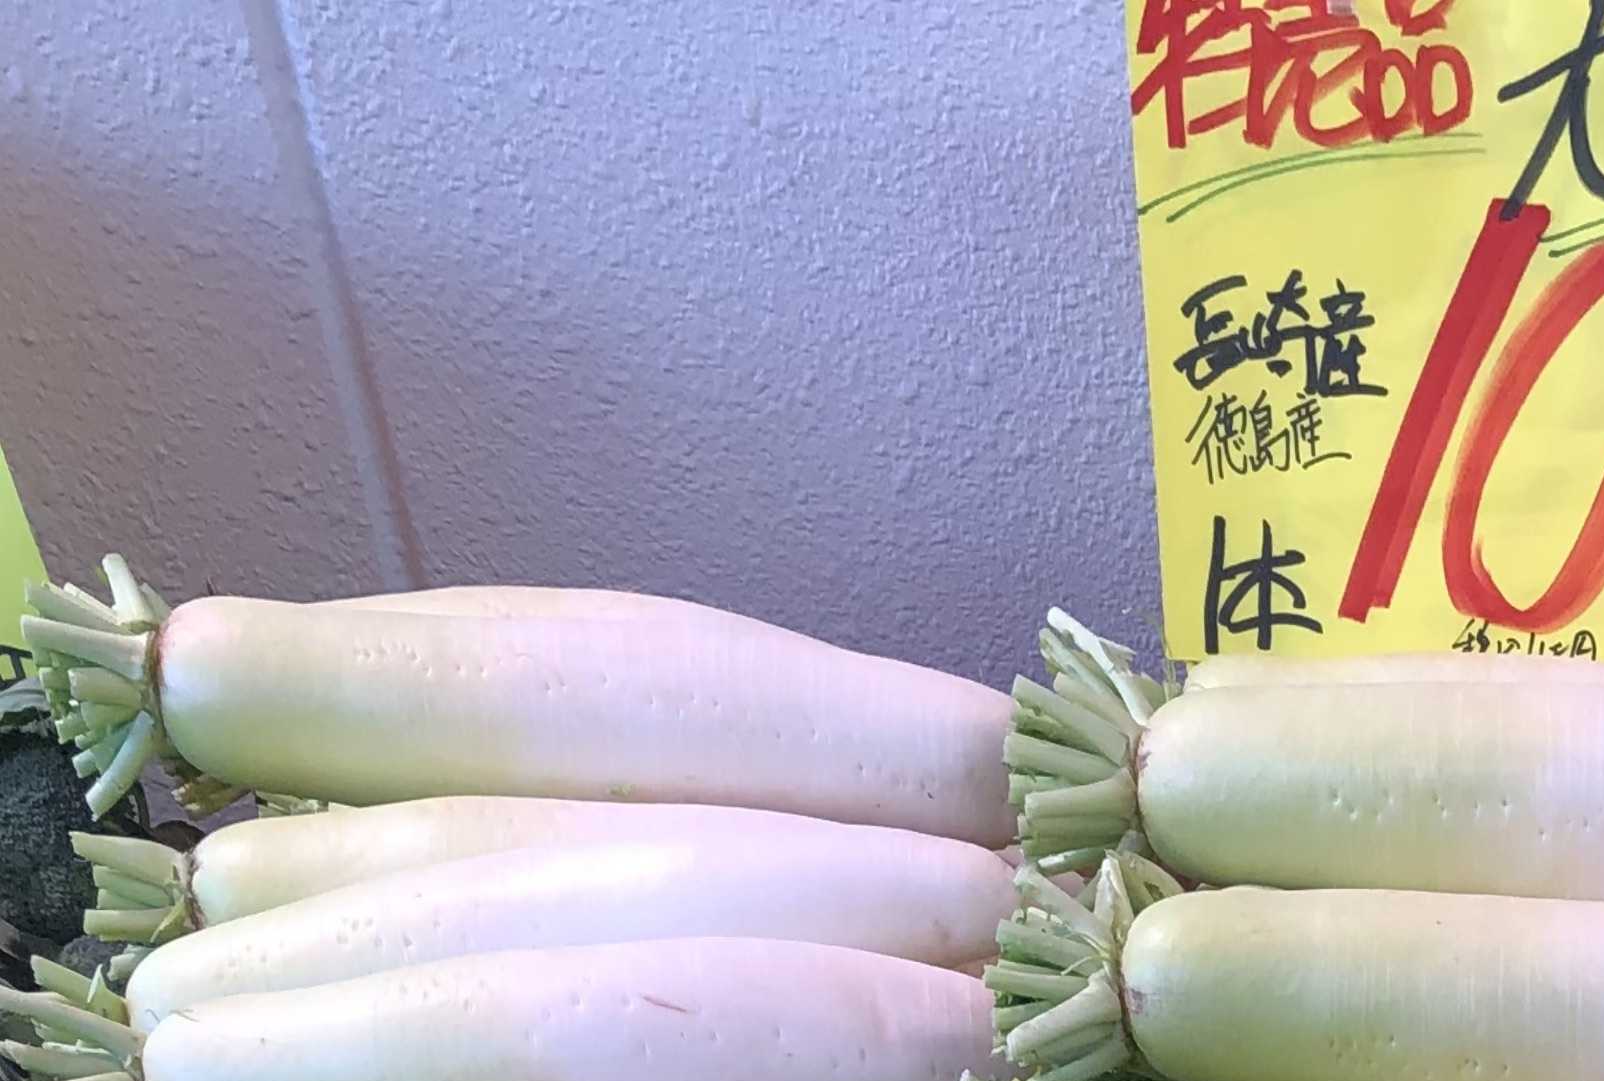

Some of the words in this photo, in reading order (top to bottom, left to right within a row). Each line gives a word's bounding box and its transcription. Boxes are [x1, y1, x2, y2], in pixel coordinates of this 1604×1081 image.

[1173, 269, 1389, 397] 長崎産
[1184, 389, 1353, 485] 徳島産
[1204, 515, 1324, 655] 1本
